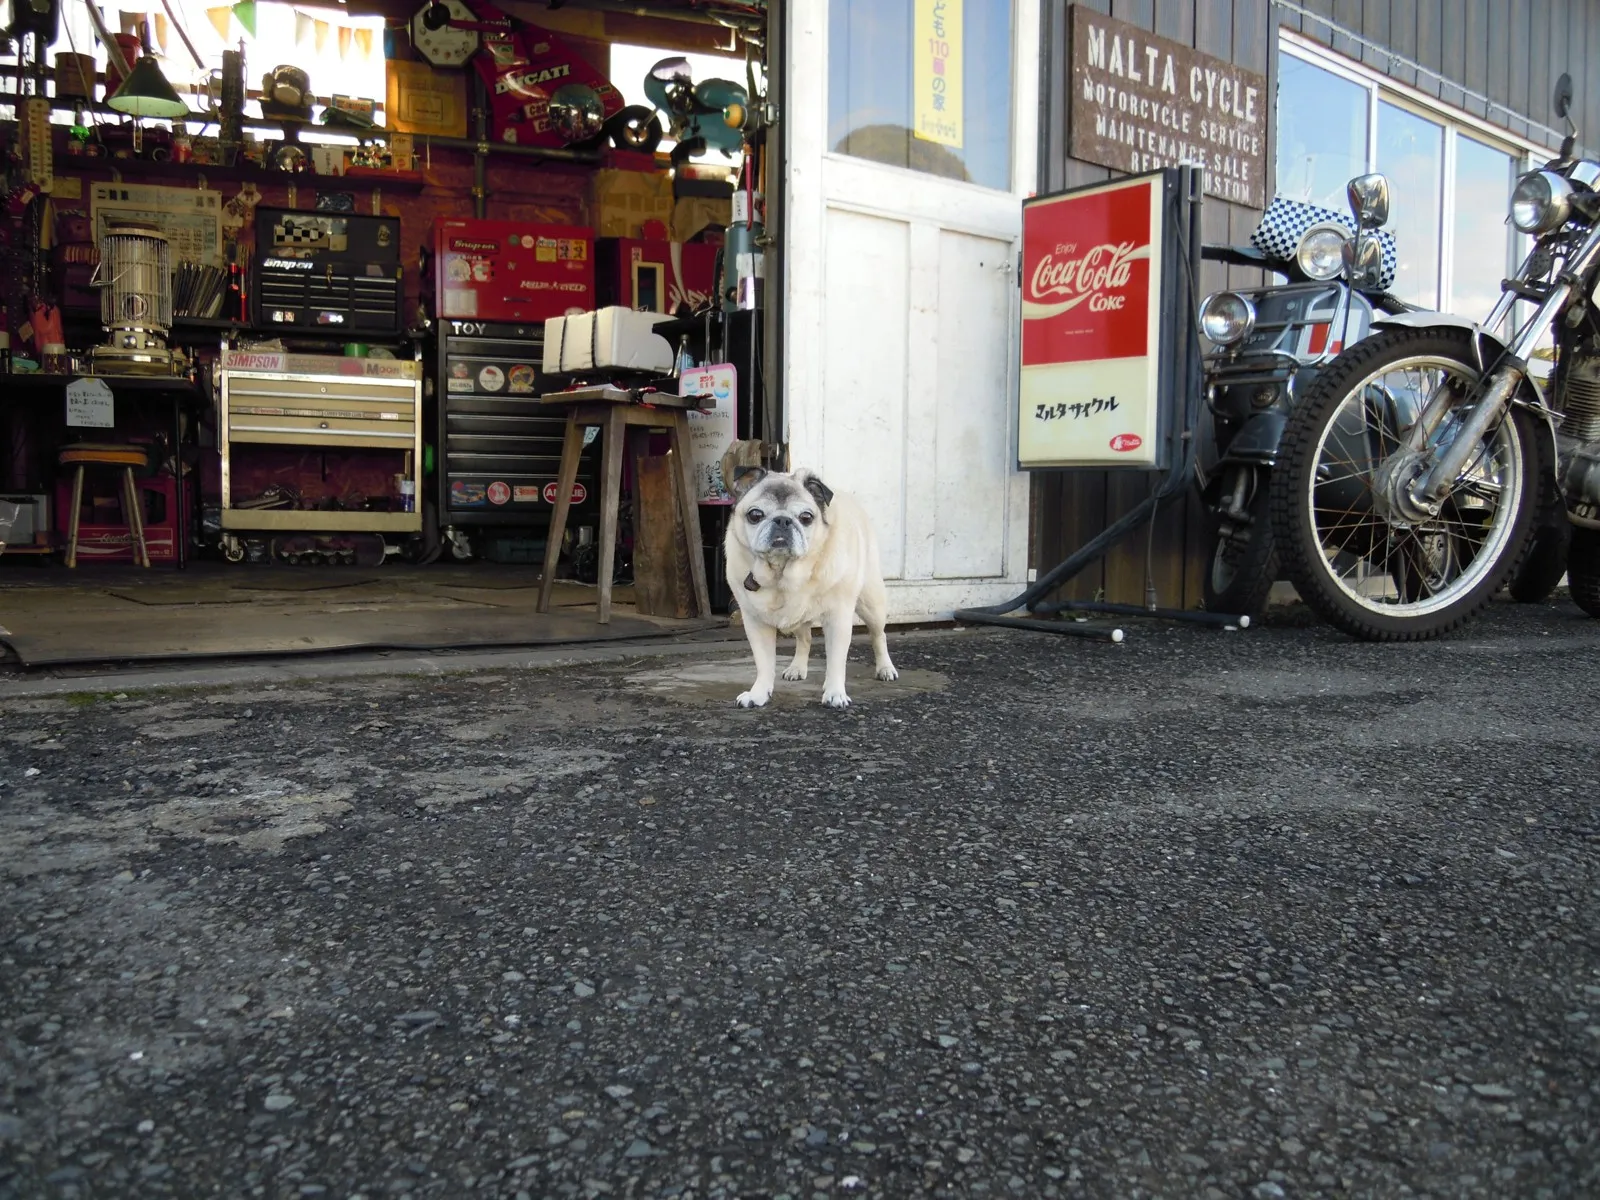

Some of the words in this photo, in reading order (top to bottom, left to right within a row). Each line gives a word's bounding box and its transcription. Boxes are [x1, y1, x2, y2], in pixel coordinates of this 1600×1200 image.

[1088, 24, 1176, 95] MALTA
[1190, 66, 1258, 124] CYCLE
[1083, 78, 1191, 134] MOTORCYCLE
[1200, 119, 1259, 157] SERVICE
[1205, 172, 1250, 202] USTOM
[1055, 243, 1078, 255] Enjoy
[1031, 241, 1135, 298] Coca-Cola
[1089, 292, 1126, 312] Coke
[451, 321, 486, 335] TOY
[227, 353, 280, 369] SIMPSON
[1035, 396, 1120, 421] マルタサイクル
